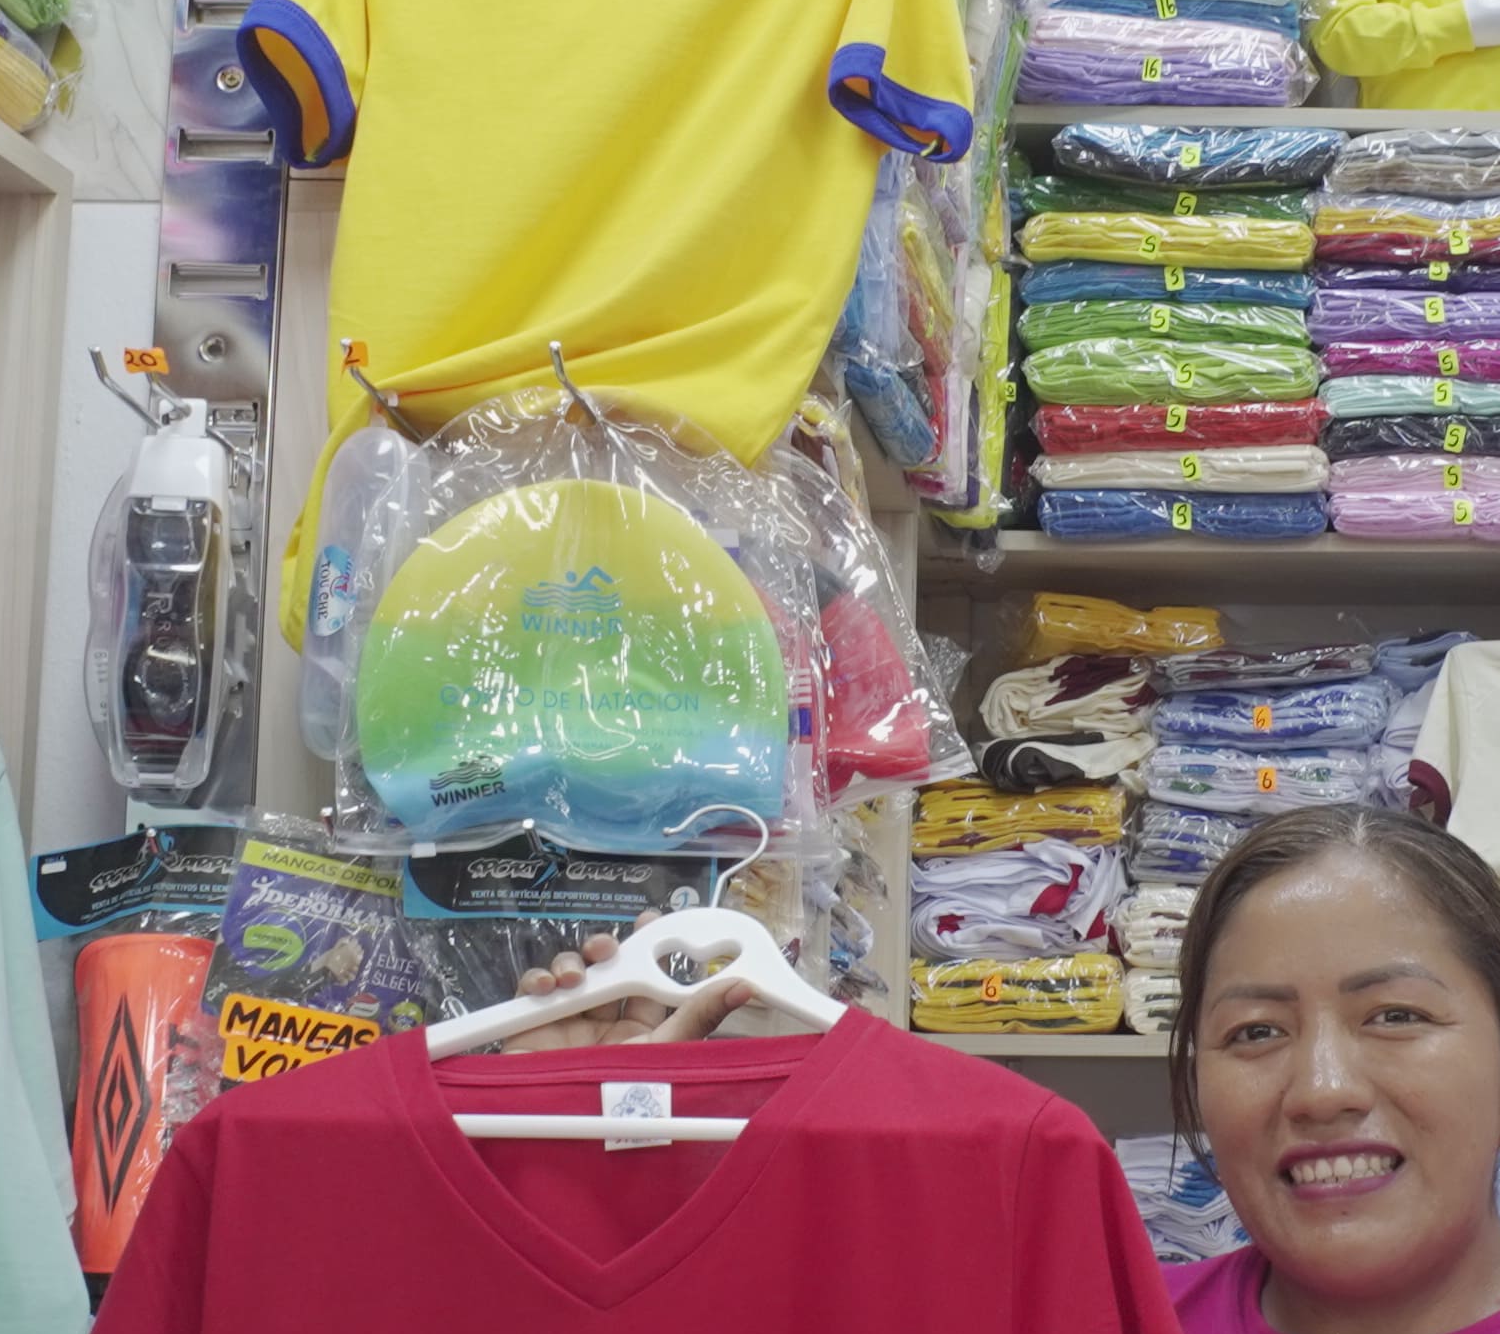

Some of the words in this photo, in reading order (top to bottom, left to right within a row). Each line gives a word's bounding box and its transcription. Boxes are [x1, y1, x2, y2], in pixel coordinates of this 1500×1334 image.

[1144, 57, 1160, 79] 16
[1177, 195, 1193, 216] S
[1141, 234, 1157, 254] S
[1451, 230, 1464, 248] S
[1150, 308, 1167, 329] S
[1428, 299, 1440, 317] S
[124, 351, 158, 367] 20
[1441, 353, 1455, 373] S
[1177, 362, 1193, 384] S
[1436, 382, 1448, 403] S
[1166, 406, 1182, 429] S
[1446, 427, 1461, 448] S
[1182, 456, 1197, 479] S
[1446, 464, 1459, 487] S
[1455, 501, 1469, 523] S
[521, 612, 624, 637] WINNER
[439, 684, 535, 714] GOO
[542, 689, 572, 711] DE
[1261, 771, 1273, 790] 6
[431, 780, 506, 808] WINNER
[262, 850, 337, 877] MANGAS
[470, 889, 495, 900] VENTA
[552, 890, 600, 903] DEPORTIVOS
[601, 892, 612, 903] EN
[613, 893, 648, 905] GENERAL
[377, 953, 414, 974] ELITE
[985, 974, 998, 998] 6
[224, 1000, 376, 1054] MANGAS
